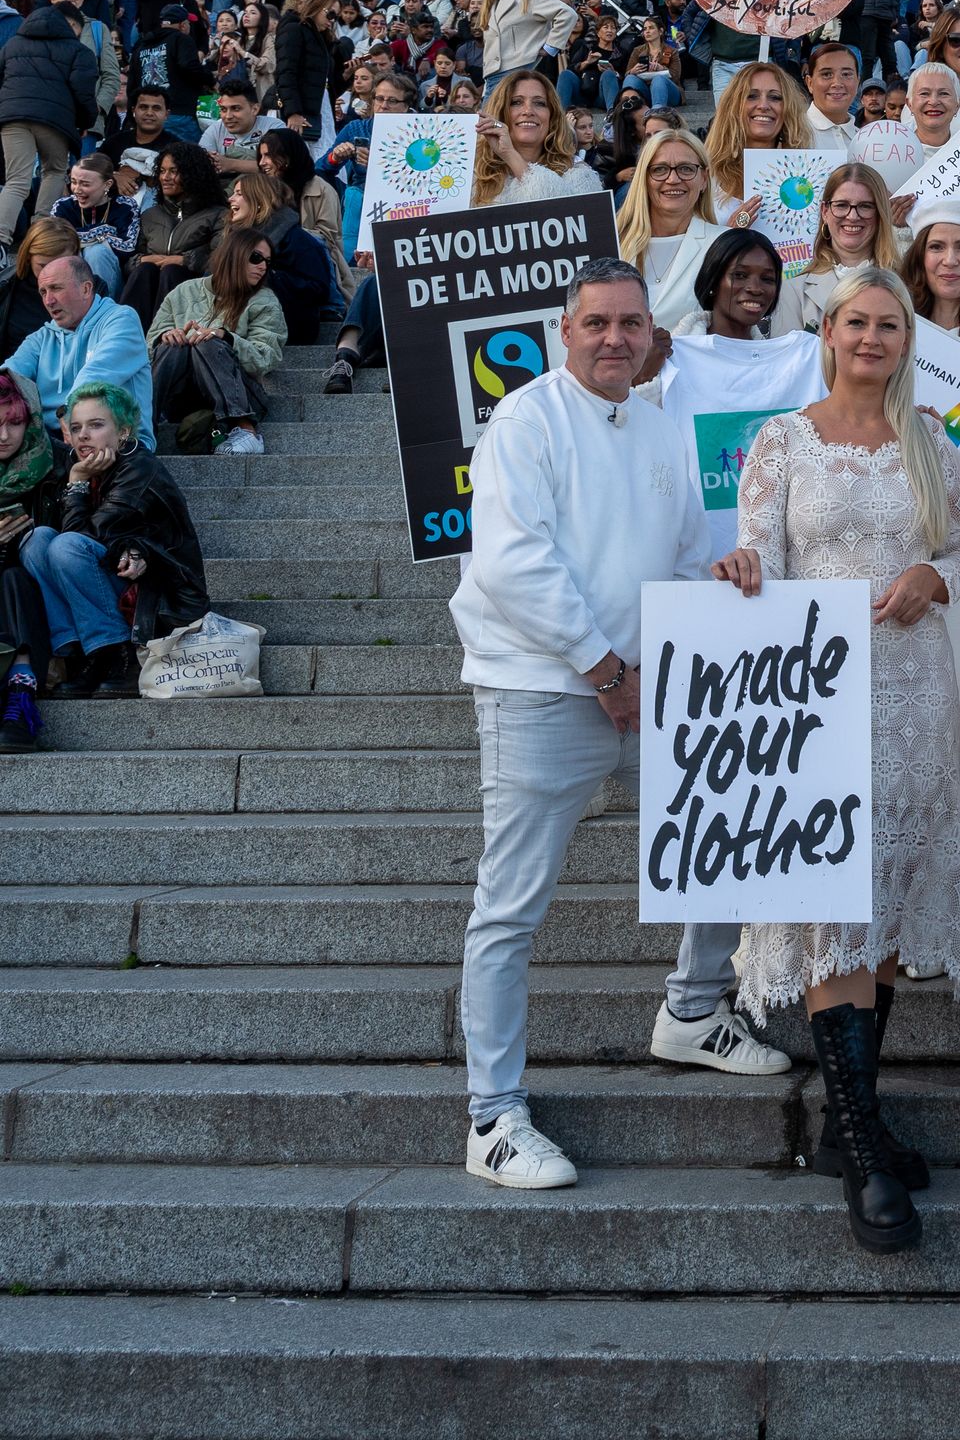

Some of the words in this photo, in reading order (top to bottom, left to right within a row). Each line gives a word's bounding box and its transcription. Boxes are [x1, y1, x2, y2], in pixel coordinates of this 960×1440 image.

[938, 164, 948, 174] a
[394, 214, 588, 268] RÉVOLUTION
[407, 275, 449, 308] DE
[456, 269, 495, 301] LA
[913, 354, 957, 386] HUMAN
[155, 665, 180, 686] and
[160, 648, 240, 670] Shakespeare
[654, 640, 675, 731] I
[687, 598, 850, 720] made
[666, 708, 825, 815] your
[647, 783, 862, 895] clothes
